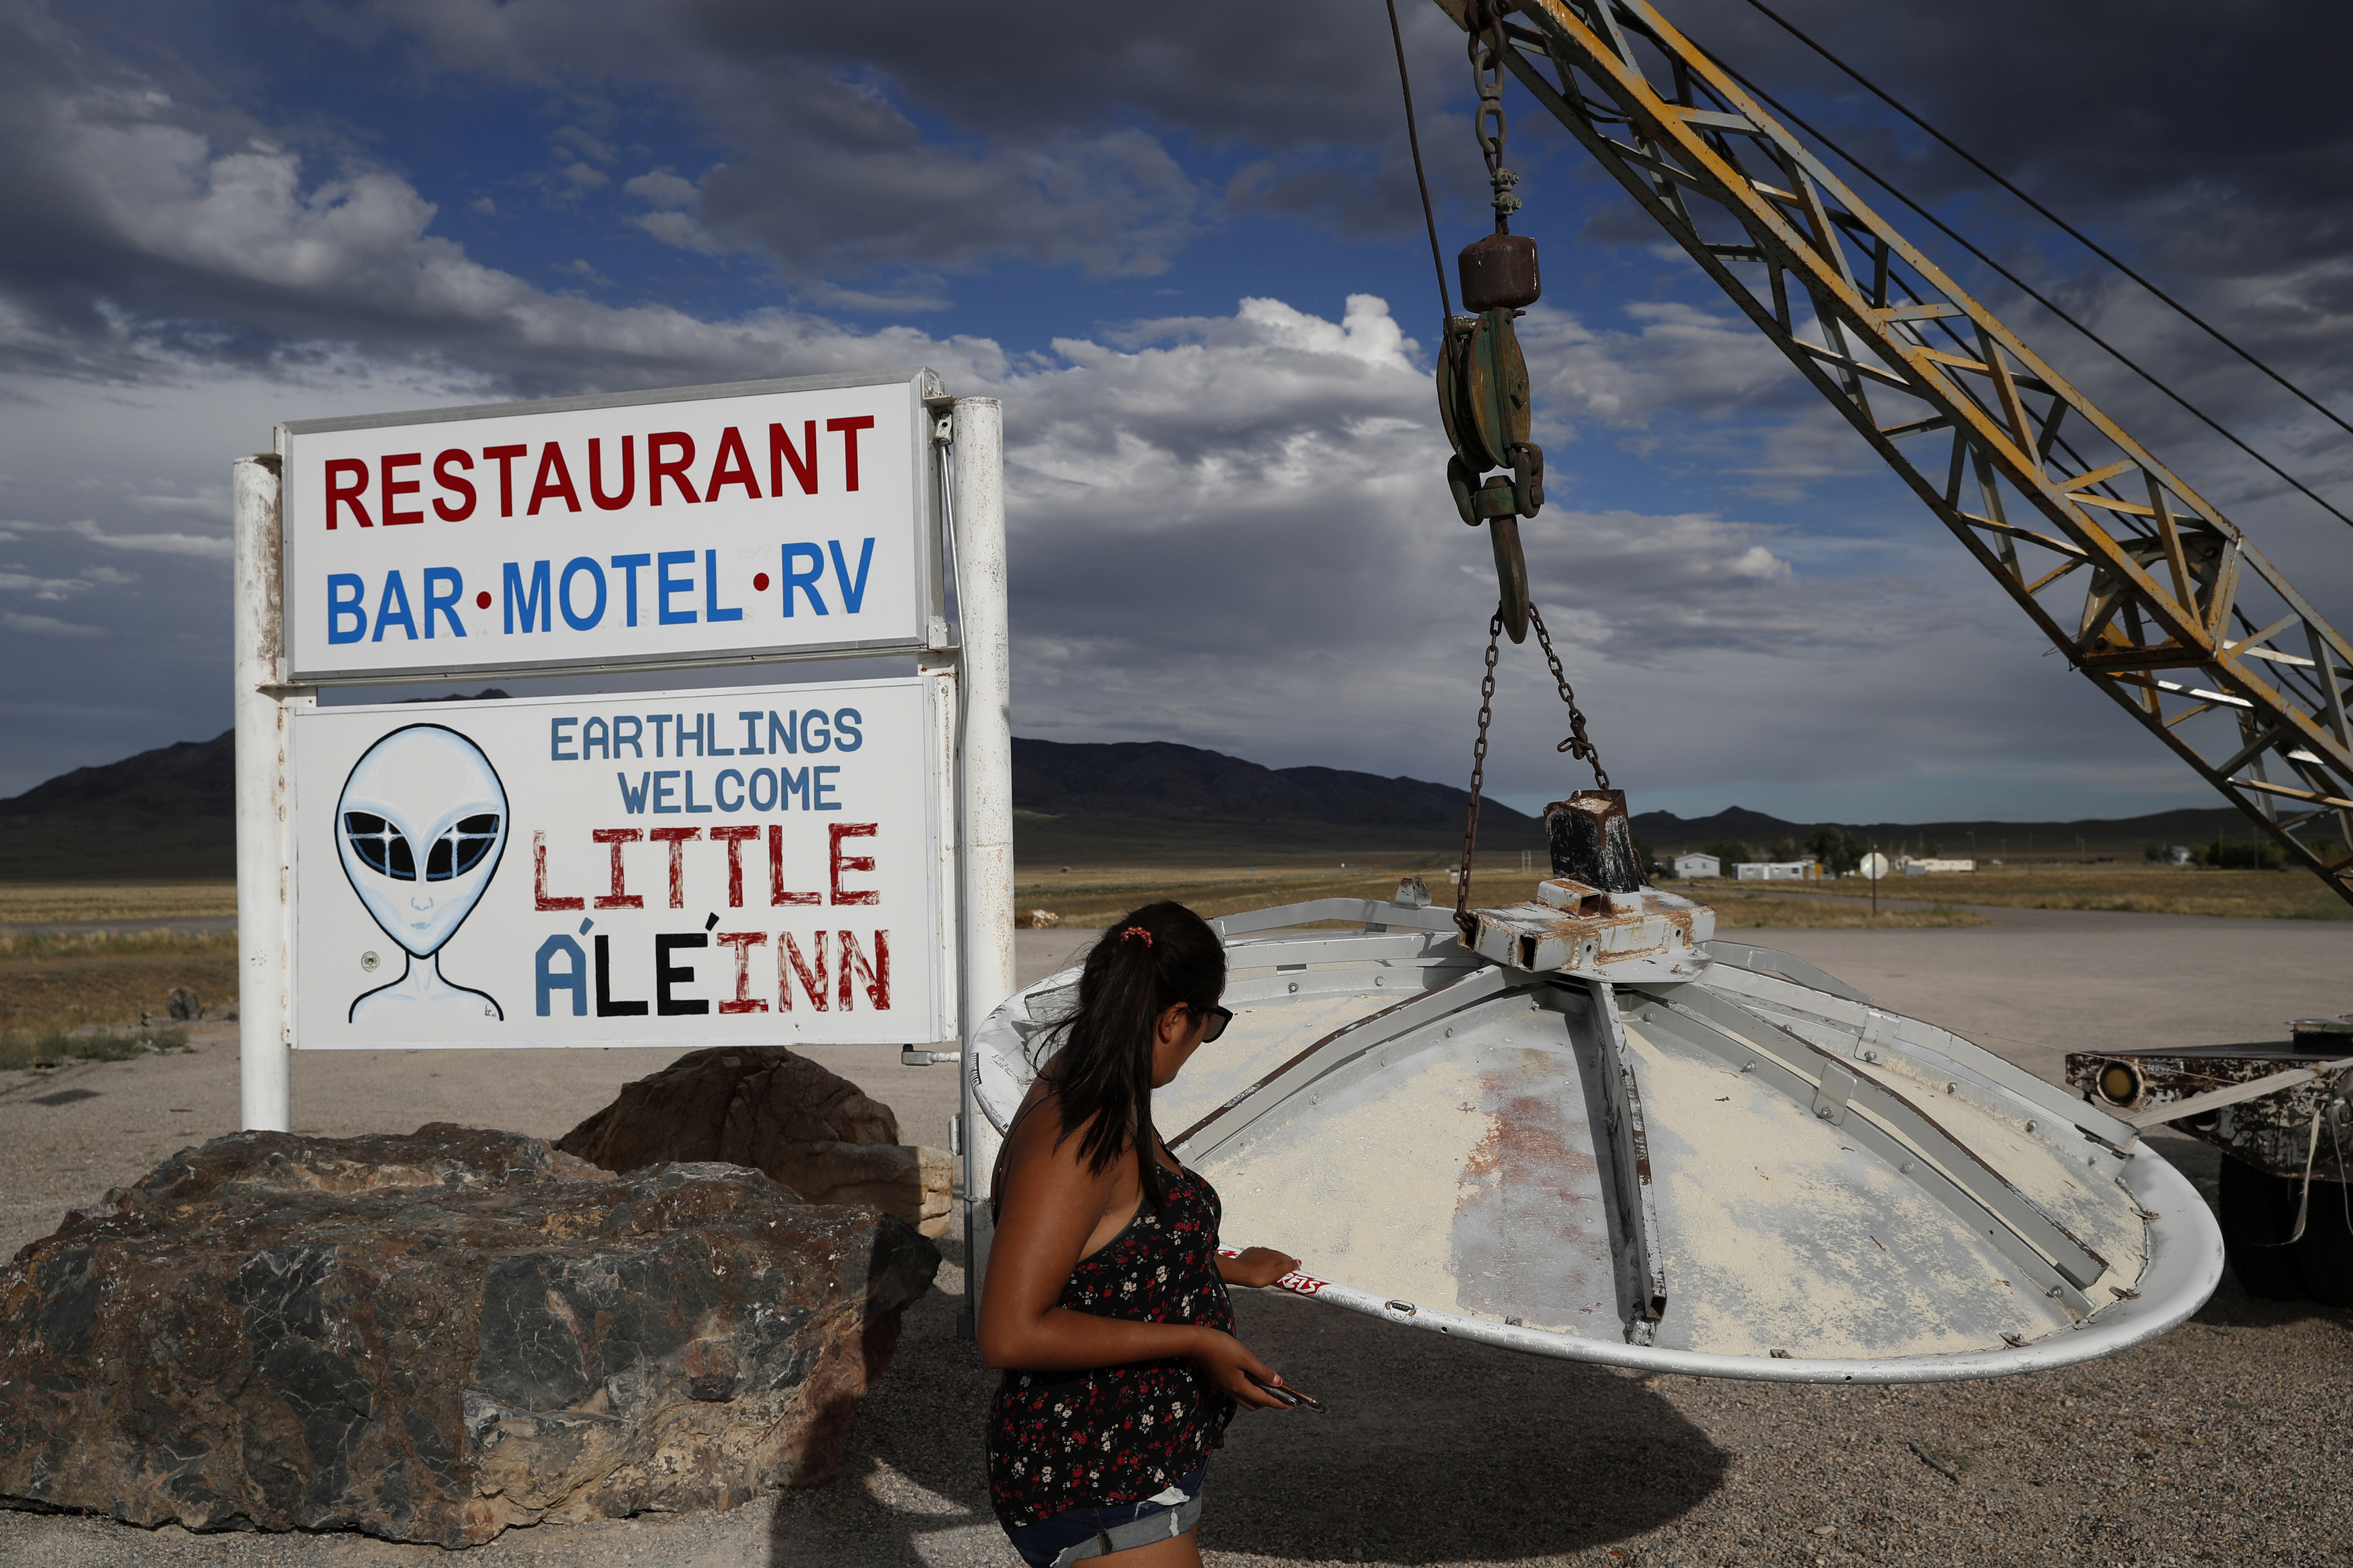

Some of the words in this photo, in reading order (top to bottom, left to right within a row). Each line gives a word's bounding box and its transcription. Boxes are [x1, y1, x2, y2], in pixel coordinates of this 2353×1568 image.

[325, 415, 875, 531] RESTAURANT
[327, 567, 468, 645] BAR
[503, 549, 743, 634] MOTEL
[781, 537, 876, 618] RV
[551, 708, 863, 761] EARTHLINGS
[618, 766, 843, 814] WELCOME
[534, 823, 881, 912] LITTLE
